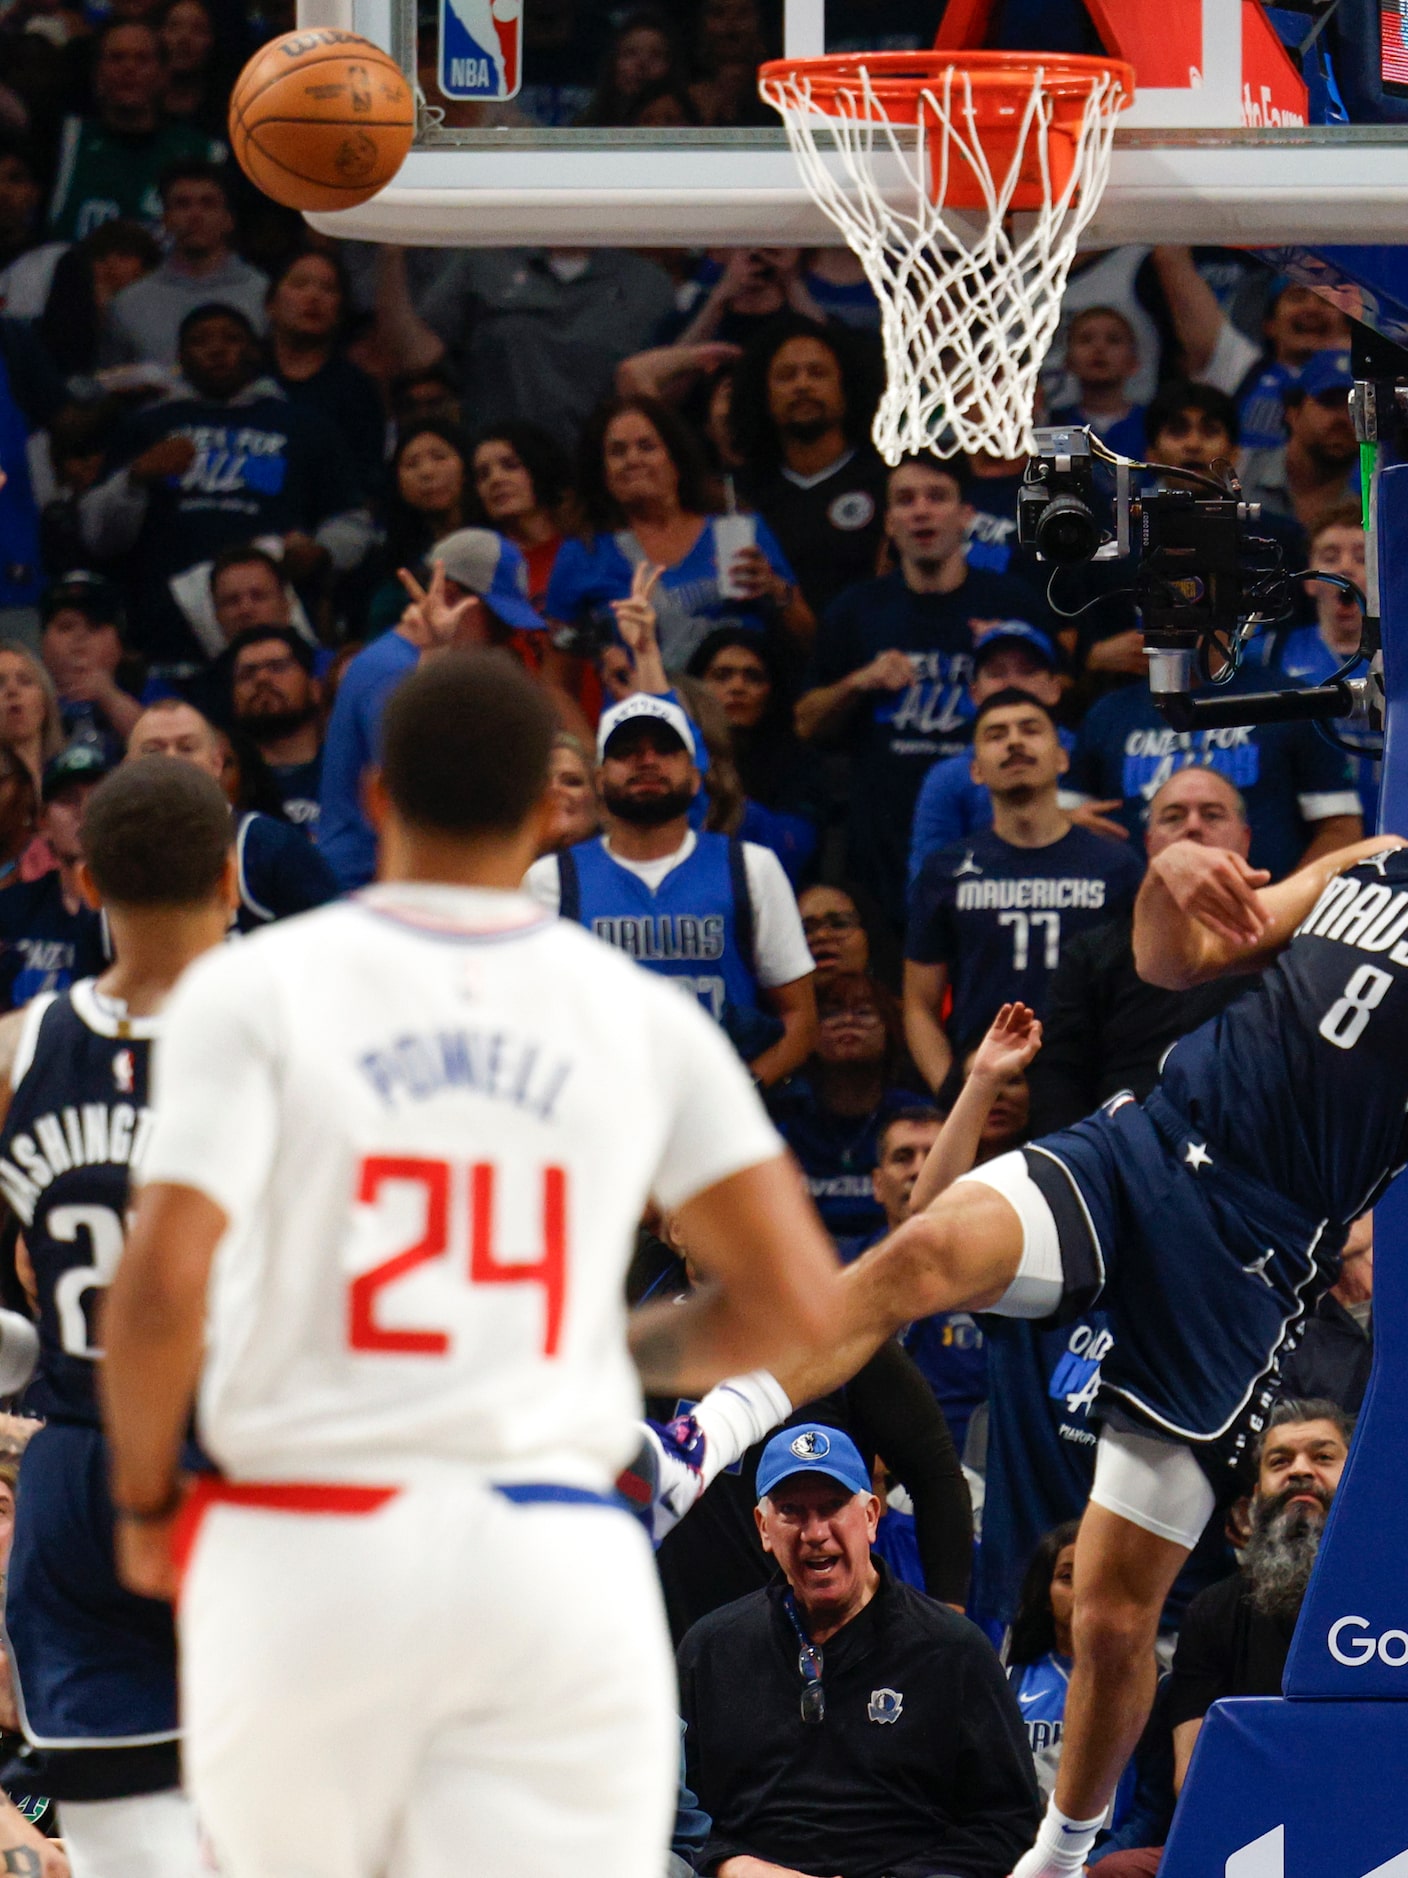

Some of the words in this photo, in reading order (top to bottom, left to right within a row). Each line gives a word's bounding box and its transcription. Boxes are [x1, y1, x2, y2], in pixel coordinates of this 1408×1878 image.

[451, 57, 490, 88] NBA
[956, 878, 1106, 911] MAVERICKS
[593, 914, 725, 960] DALLAS
[997, 911, 1061, 971] 77
[1319, 964, 1395, 1049] 8
[359, 1030, 573, 1120] POWELL
[47, 1205, 136, 1358] 2
[349, 1155, 566, 1354] 24
